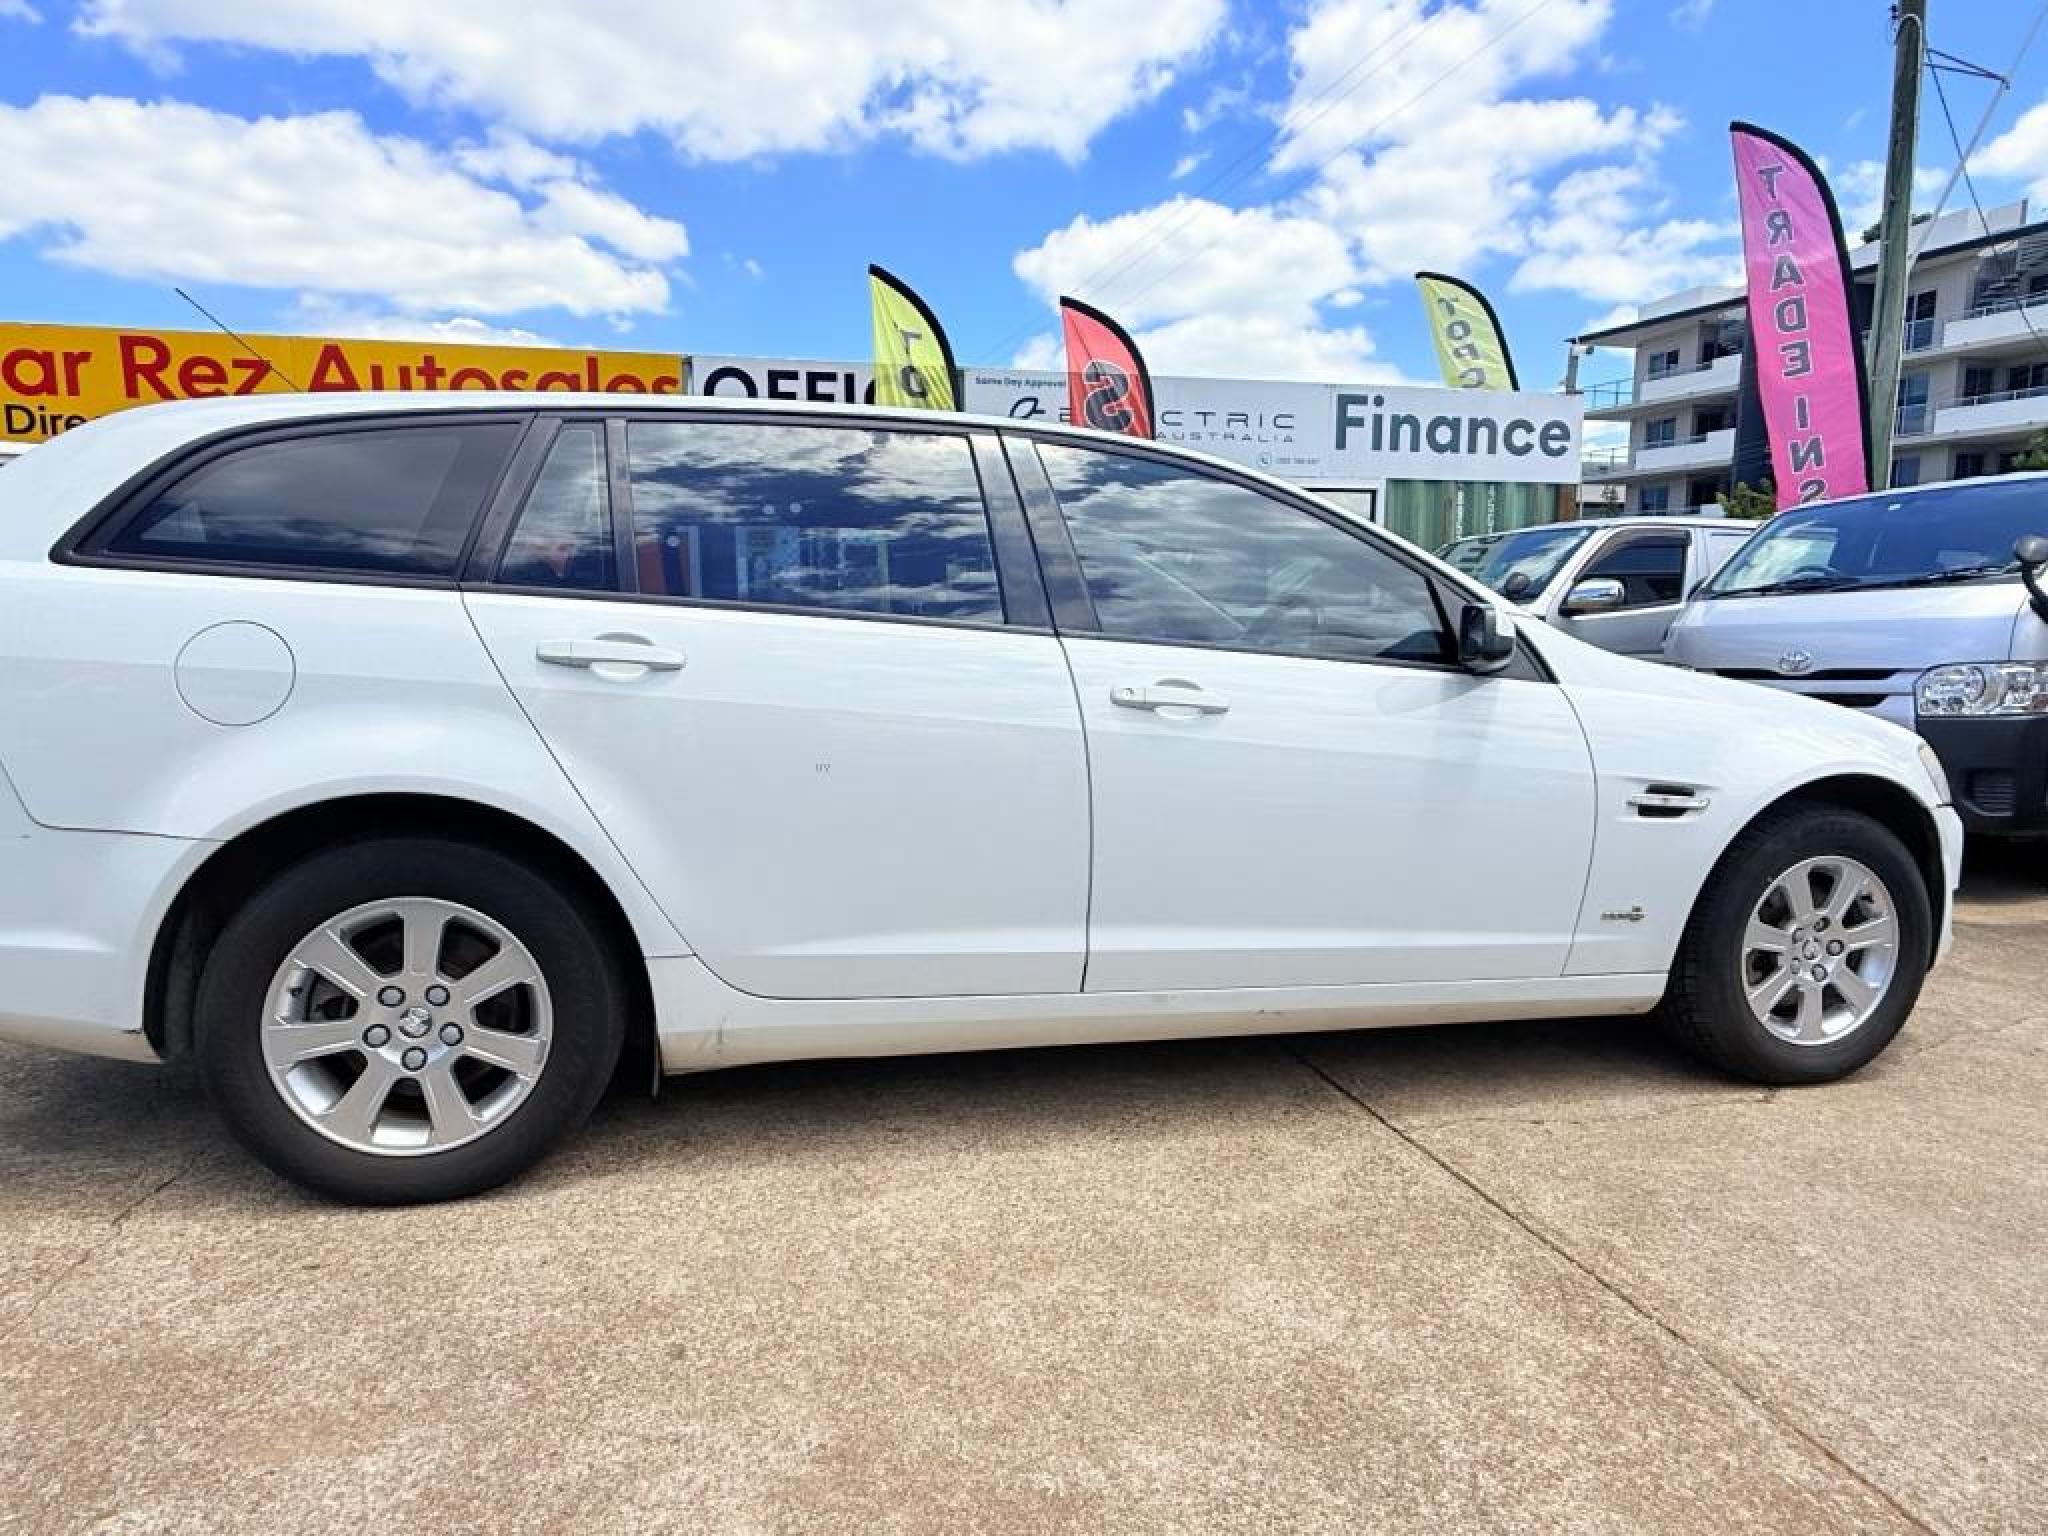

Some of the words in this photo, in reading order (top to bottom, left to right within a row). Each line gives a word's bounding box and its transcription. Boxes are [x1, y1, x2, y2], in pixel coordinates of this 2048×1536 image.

[118, 335, 271, 400] Rez
[703, 365, 876, 405] OFFI
[4, 403, 101, 436] Dire
[1155, 431, 1294, 443] AUSTRALIA
[1334, 393, 1572, 457] Finance
